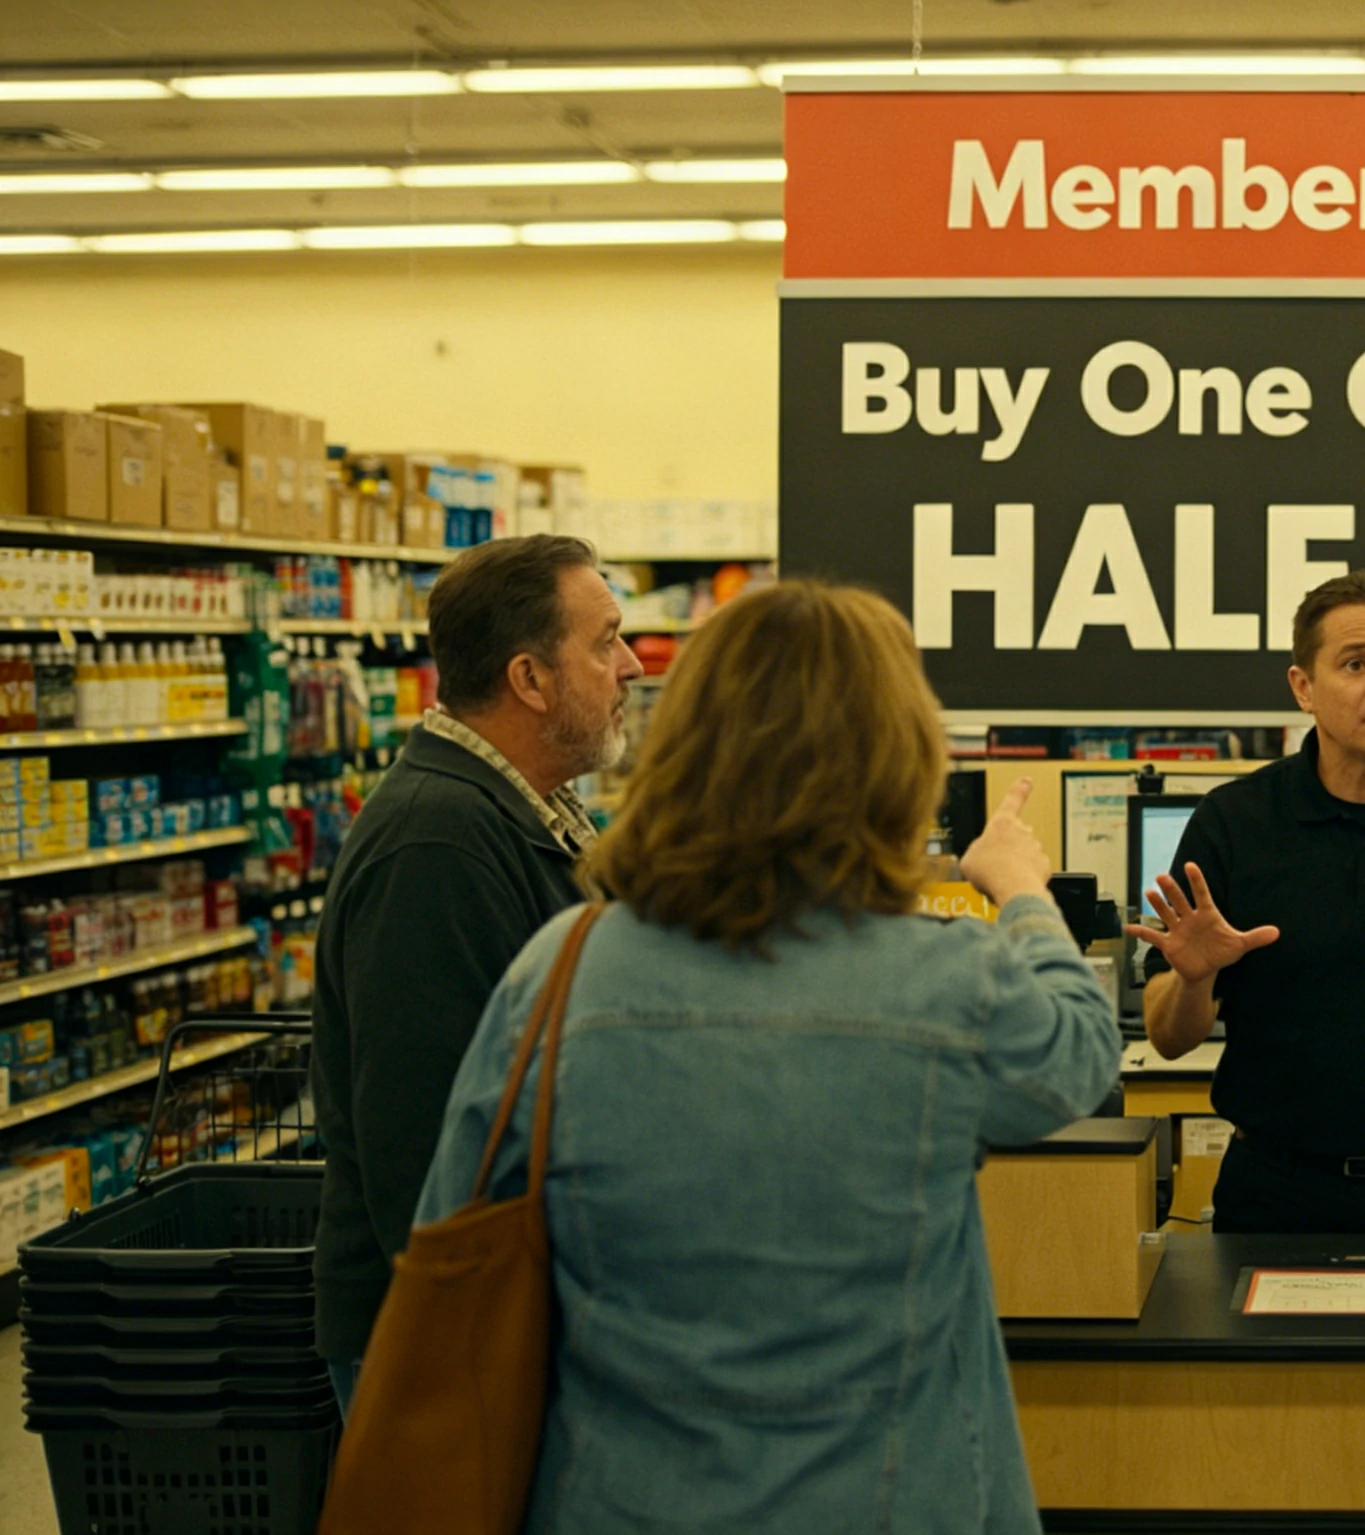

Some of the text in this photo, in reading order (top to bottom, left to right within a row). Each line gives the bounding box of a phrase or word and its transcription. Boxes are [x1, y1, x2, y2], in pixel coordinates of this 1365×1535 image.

[841, 341, 1051, 461] Buy
[1080, 340, 1313, 437] One
[912, 503, 1356, 651] HALF
